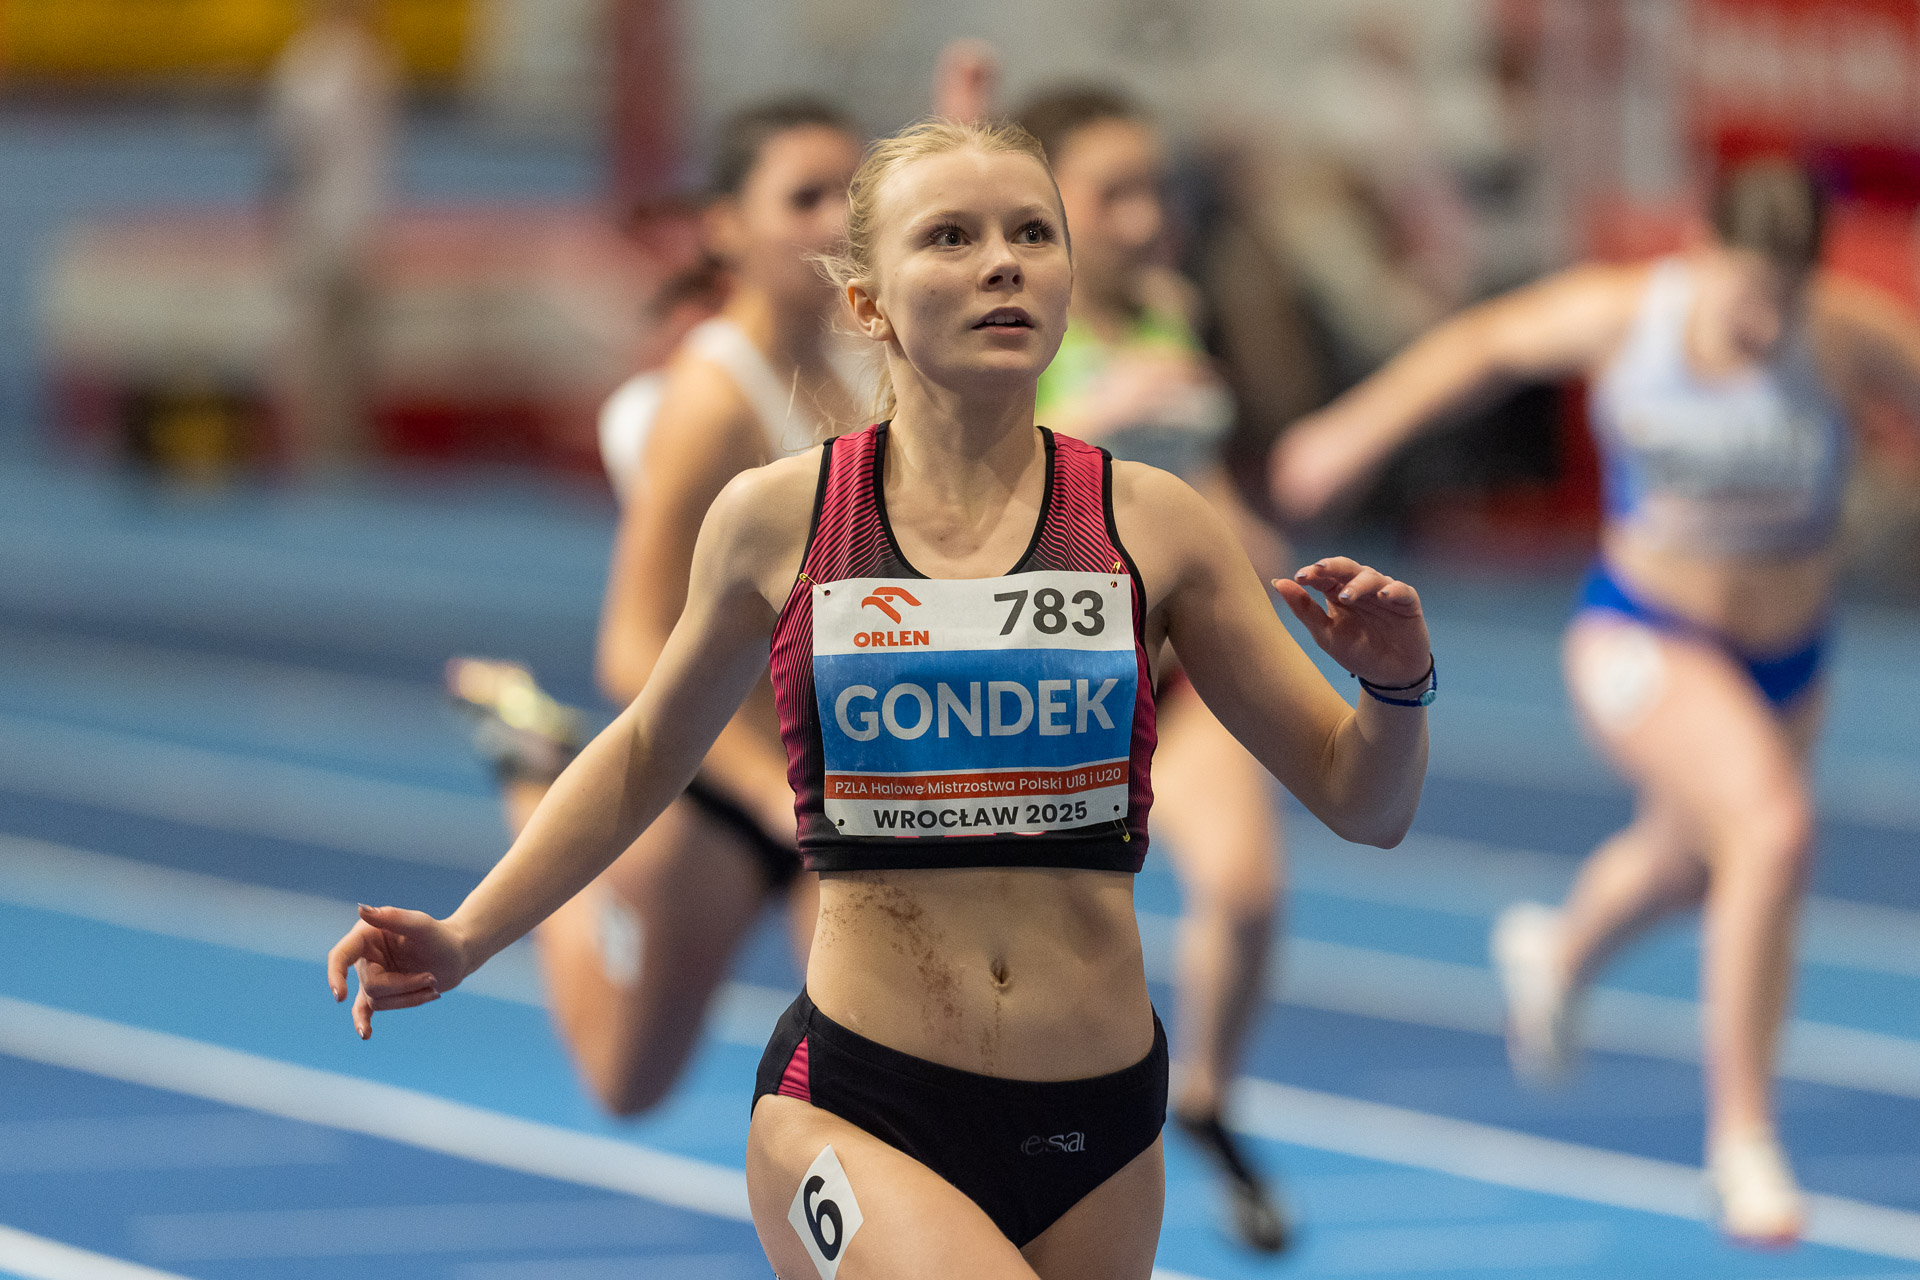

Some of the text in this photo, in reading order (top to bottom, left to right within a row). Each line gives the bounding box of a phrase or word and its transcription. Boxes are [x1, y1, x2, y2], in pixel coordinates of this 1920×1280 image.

[994, 588, 1105, 636] 783
[853, 630, 929, 647] ORLEN
[834, 678, 1119, 741] GONDEK
[835, 768, 1121, 797] PZLA Halowe Mistrzostwa Polski U18 i U20
[873, 801, 1088, 829] WROCŁAW 2025
[803, 1175, 843, 1261] 6
